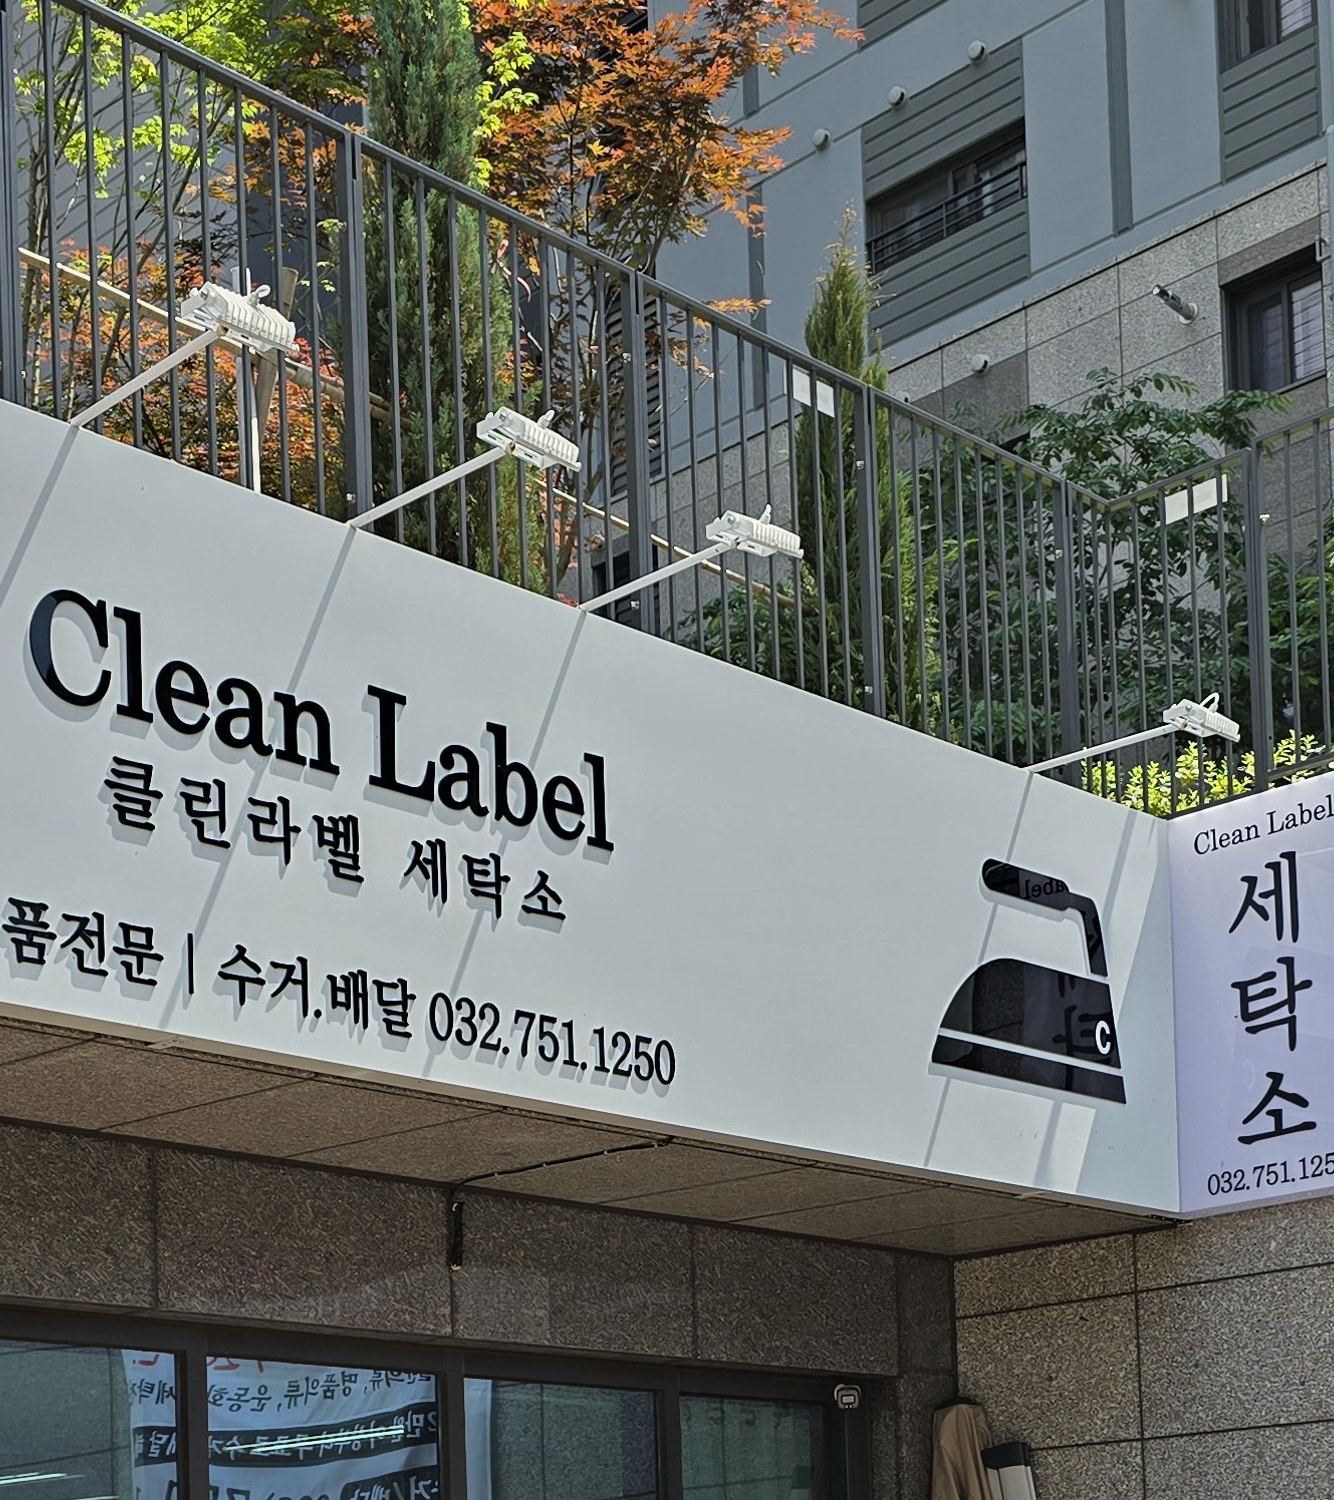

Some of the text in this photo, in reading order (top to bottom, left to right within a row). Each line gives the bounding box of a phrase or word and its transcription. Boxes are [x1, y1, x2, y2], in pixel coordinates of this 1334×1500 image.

[29, 588, 615, 851] Clean Label
[104, 755, 568, 922] 클린라벨 세탁소
[1194, 794, 1334, 856] Clean Label
[217, 944, 418, 1040] 수거.배달
[429, 991, 677, 1086] 032.751.1250
[1229, 850, 1317, 1146] 세탁소
